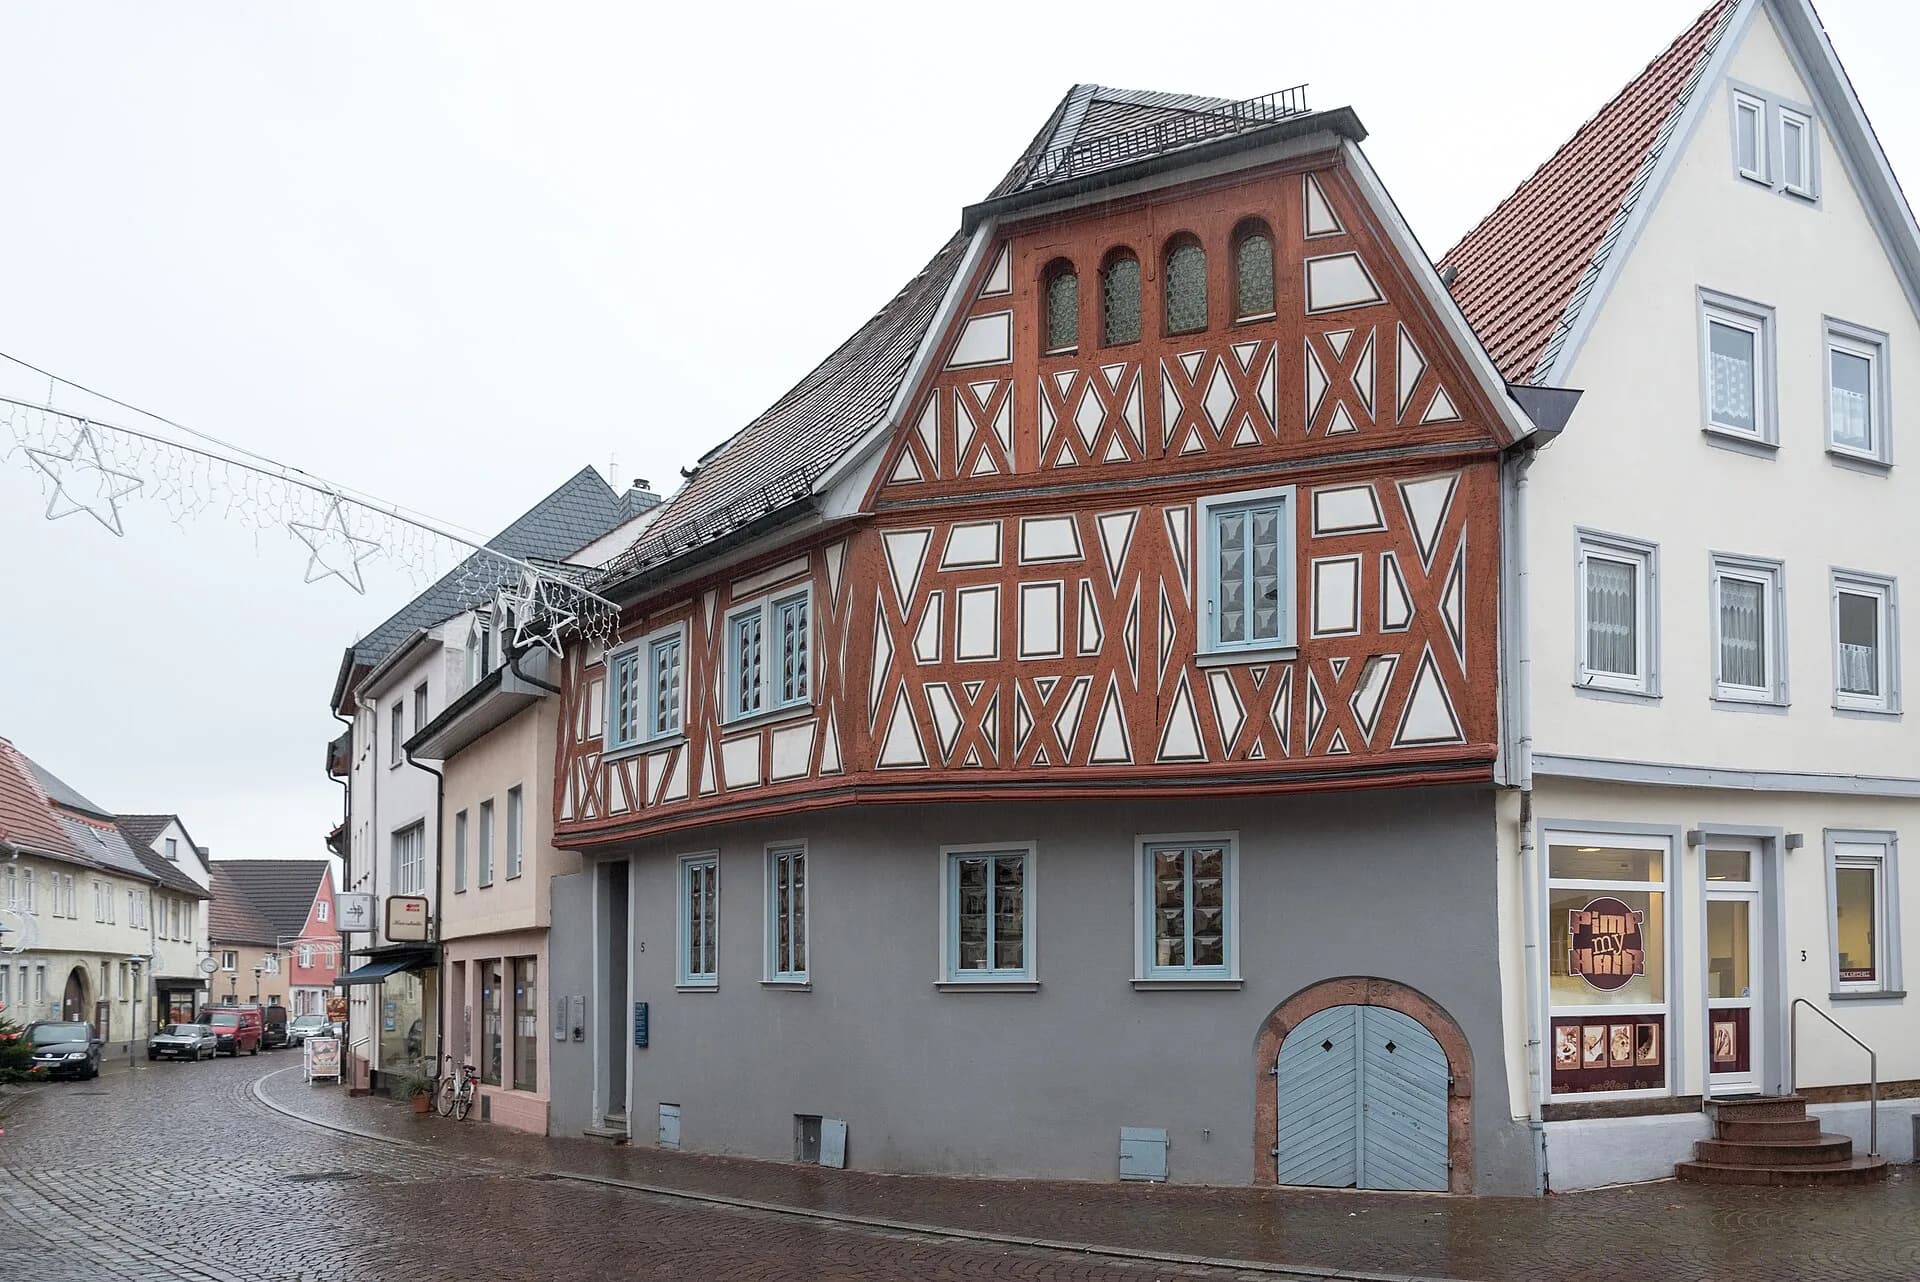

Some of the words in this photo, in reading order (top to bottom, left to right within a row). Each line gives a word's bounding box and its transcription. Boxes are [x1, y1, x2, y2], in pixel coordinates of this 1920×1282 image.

[640, 941, 646, 953] 5
[1592, 932, 1625, 956] my
[1800, 950, 1807, 962] 3
